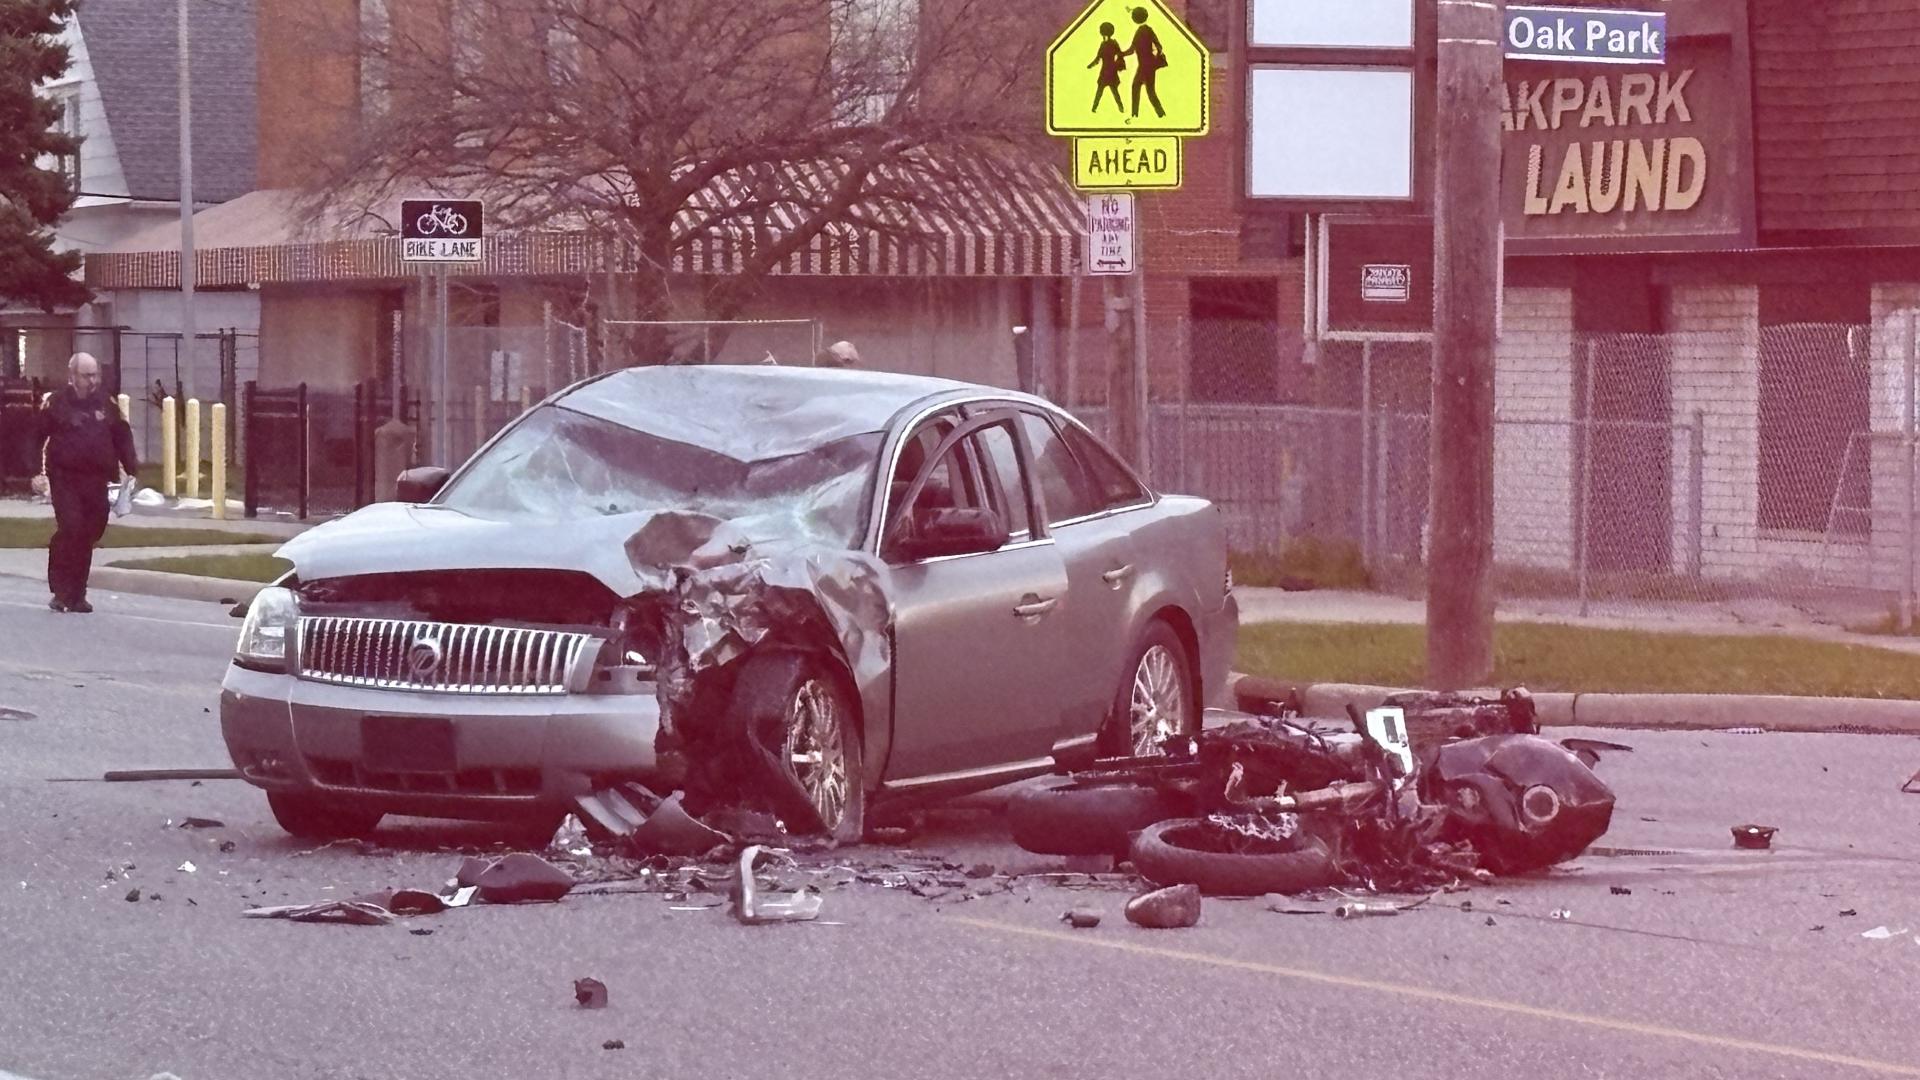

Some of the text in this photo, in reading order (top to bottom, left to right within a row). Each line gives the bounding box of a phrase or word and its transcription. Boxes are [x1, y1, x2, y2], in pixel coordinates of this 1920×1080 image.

[1508, 16, 1661, 54] Oak Park
[1088, 149, 1167, 175] AHEAD
[1523, 137, 1707, 214] LAUND
[1102, 198, 1119, 215] NO
[406, 241, 477, 257] BIKE LANE
[1101, 246, 1121, 256] TIME
